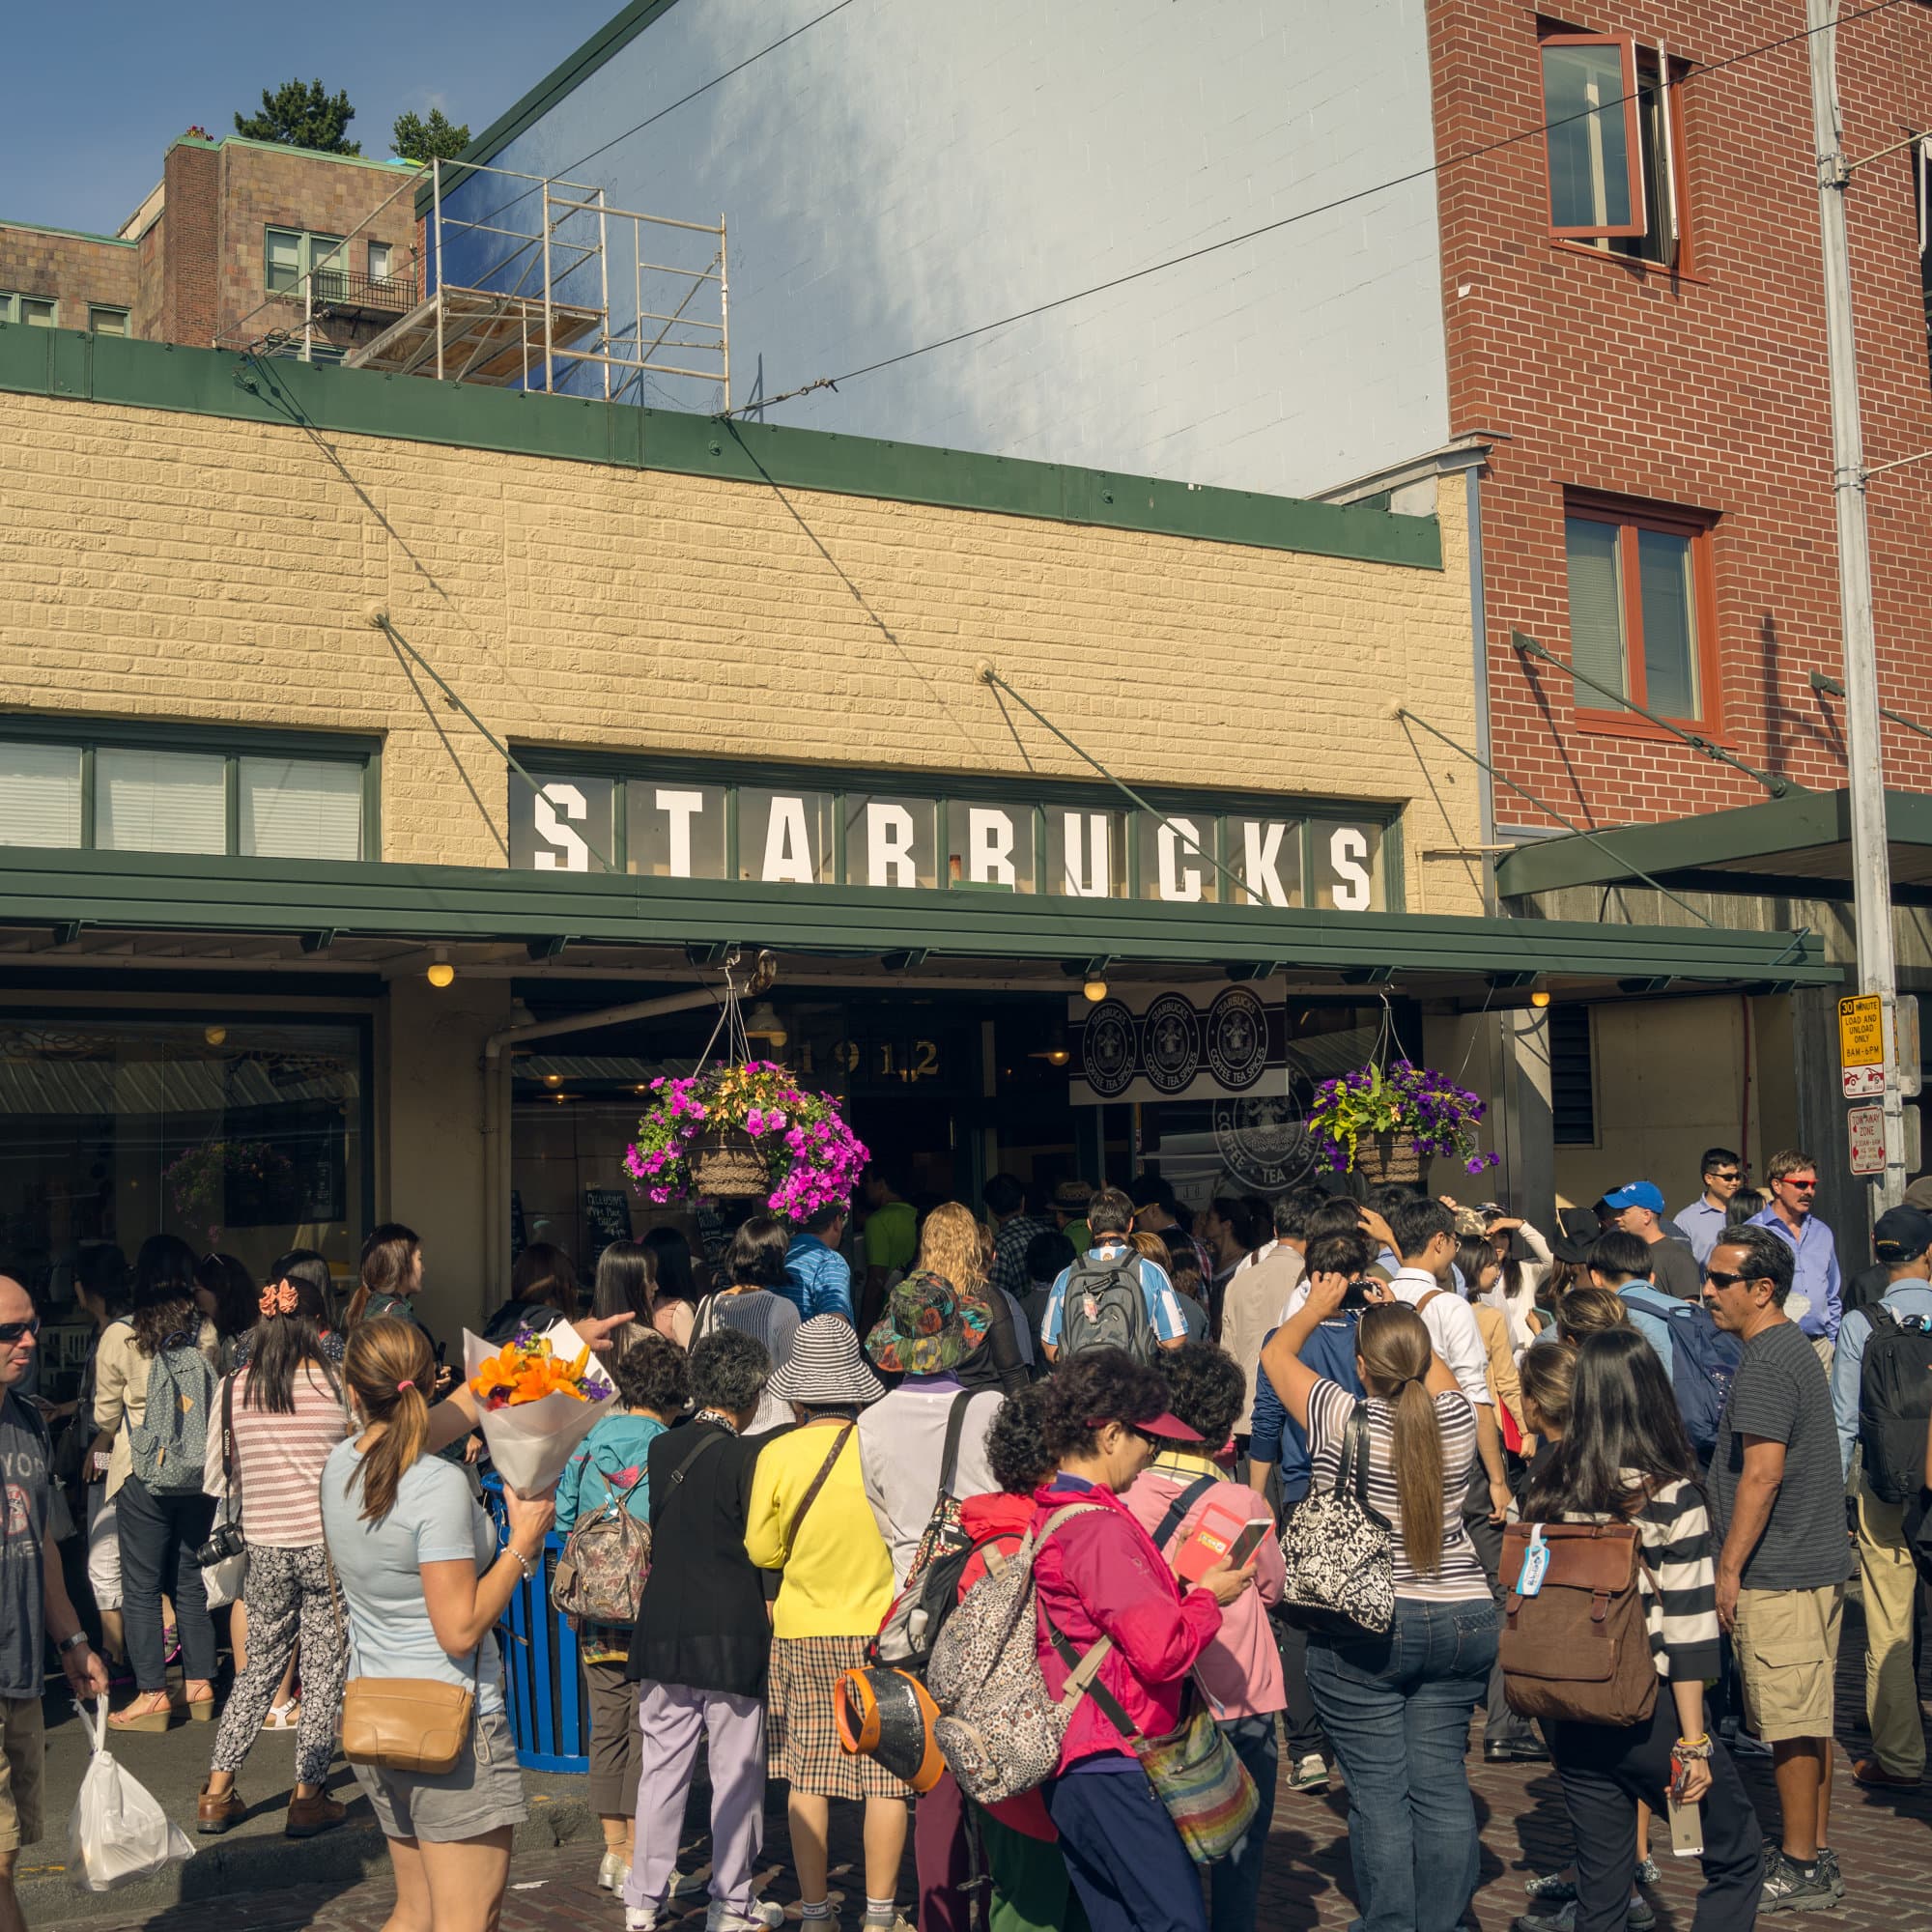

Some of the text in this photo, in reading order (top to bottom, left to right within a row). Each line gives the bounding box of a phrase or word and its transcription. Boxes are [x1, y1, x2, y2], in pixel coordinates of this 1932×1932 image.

[534, 783, 1371, 911] STARBUCKS
[1151, 1001, 1188, 1023] STARBUCKS
[1216, 994, 1256, 1016] STARBUCKS
[1841, 1002, 1854, 1014] 30
[1092, 1009, 1126, 1025] STARBUCKS
[1845, 1014, 1877, 1026] LOAD AND
[1849, 1025, 1874, 1035] UNLOAD
[1854, 1034, 1870, 1043] ONLY
[801, 1038, 940, 1075] 1912
[1210, 1048, 1231, 1081] COFFEE
[1233, 1071, 1245, 1082] TEA
[1247, 1046, 1265, 1077] SPICES
[1086, 1055, 1134, 1089] COFFEE TEA SPICES
[1146, 1051, 1198, 1087] COFFEE TEA SPICES
[1852, 1114, 1880, 1125] TOW AWAY
[1860, 1125, 1875, 1136] ZONE
[1217, 1111, 1247, 1170] COFFEE
[1262, 1167, 1286, 1183] TEA
